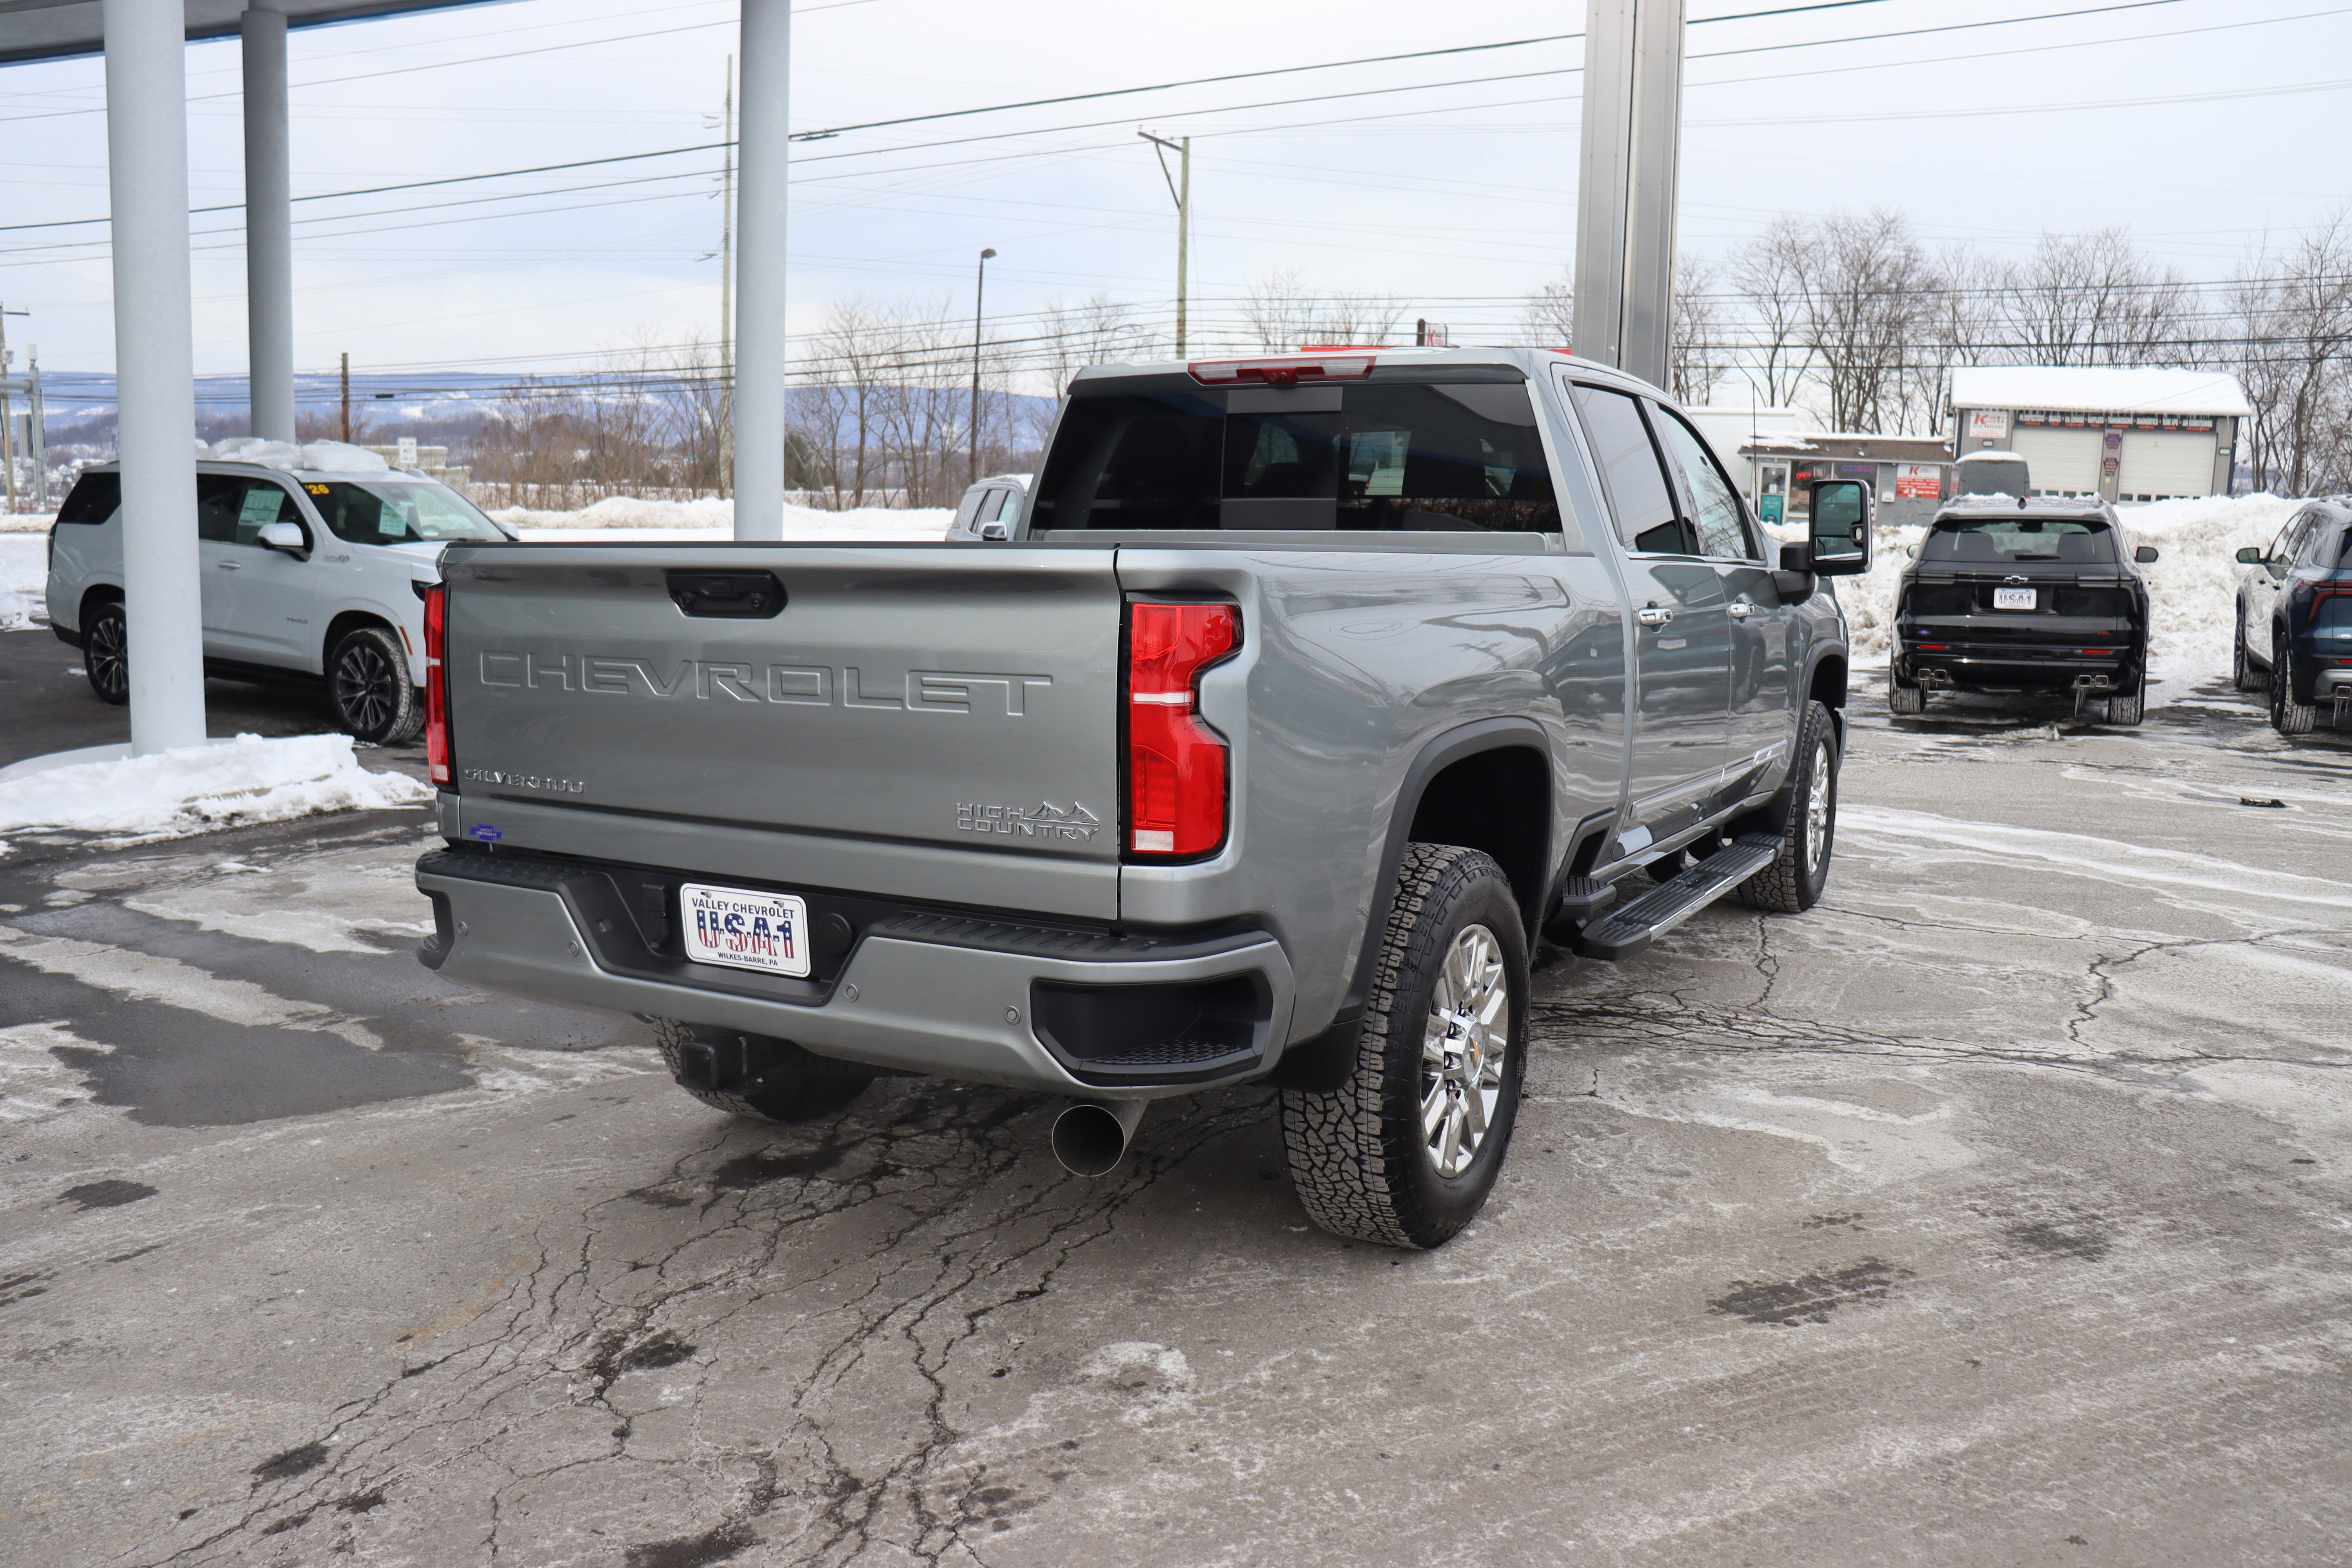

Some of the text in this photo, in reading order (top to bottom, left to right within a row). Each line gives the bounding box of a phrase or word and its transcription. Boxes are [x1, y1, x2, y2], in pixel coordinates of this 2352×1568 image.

[480, 651, 1052, 716] CHEVROLET
[465, 768, 584, 793] SILVERADO
[956, 803, 1025, 820] HIGH
[956, 818, 1099, 841] COUNTRY
[692, 898, 795, 919] VALLEY CHEVROLET
[717, 952, 768, 966] WILKES-BARRE,
